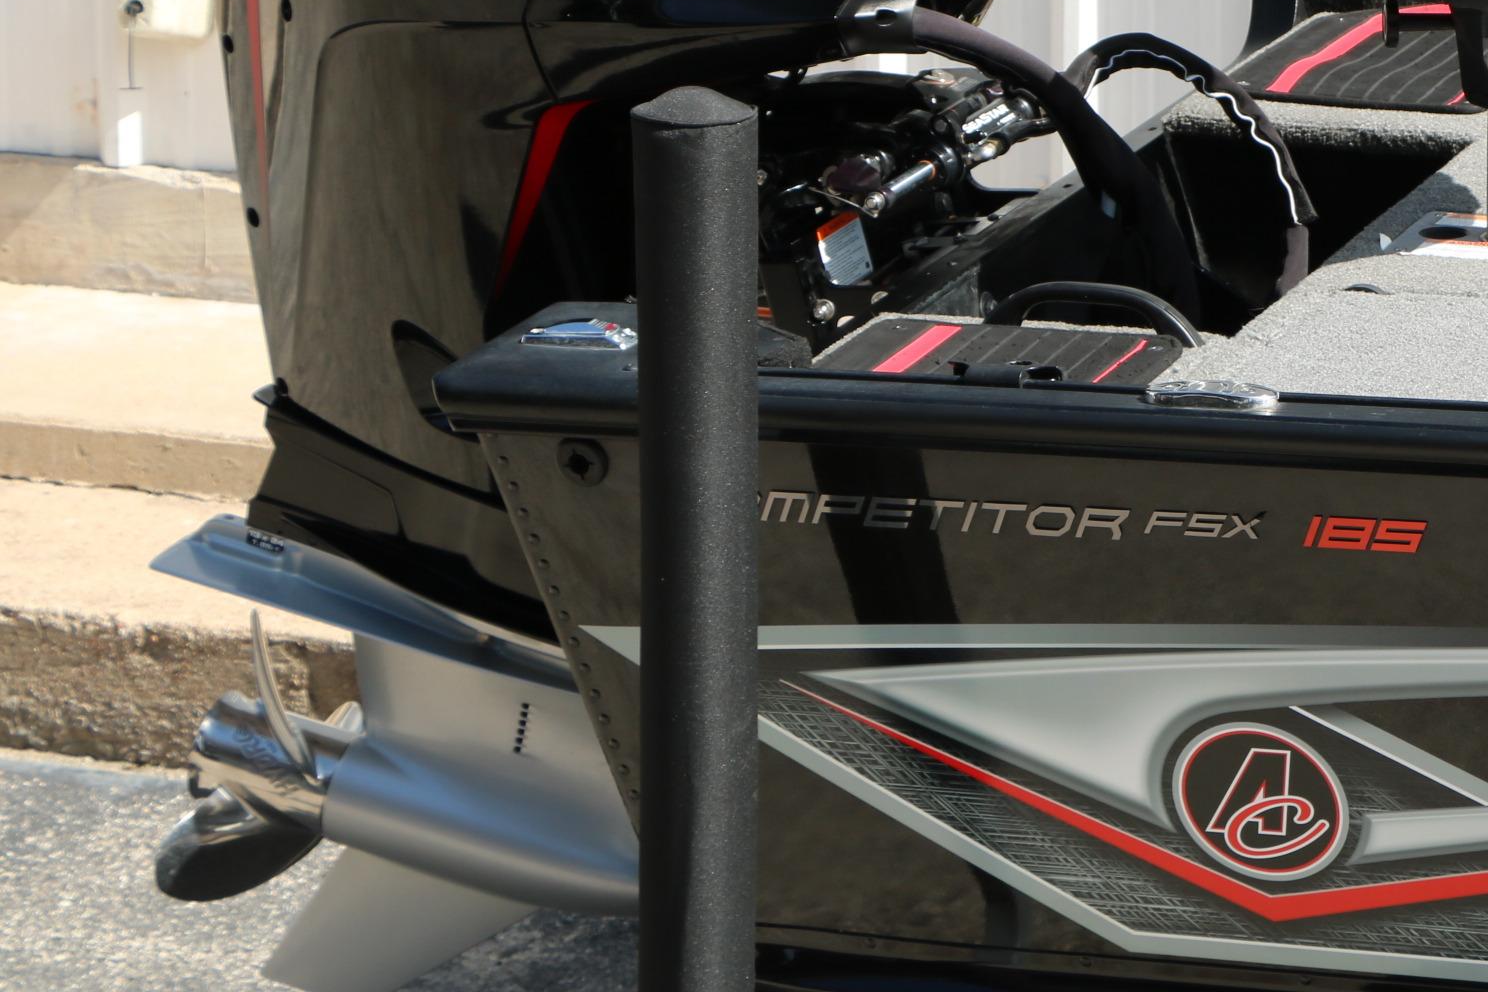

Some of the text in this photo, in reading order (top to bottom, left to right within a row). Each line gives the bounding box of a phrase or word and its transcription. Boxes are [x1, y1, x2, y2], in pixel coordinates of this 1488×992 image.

[756, 490, 1428, 553] MPETITOR FSX 185
